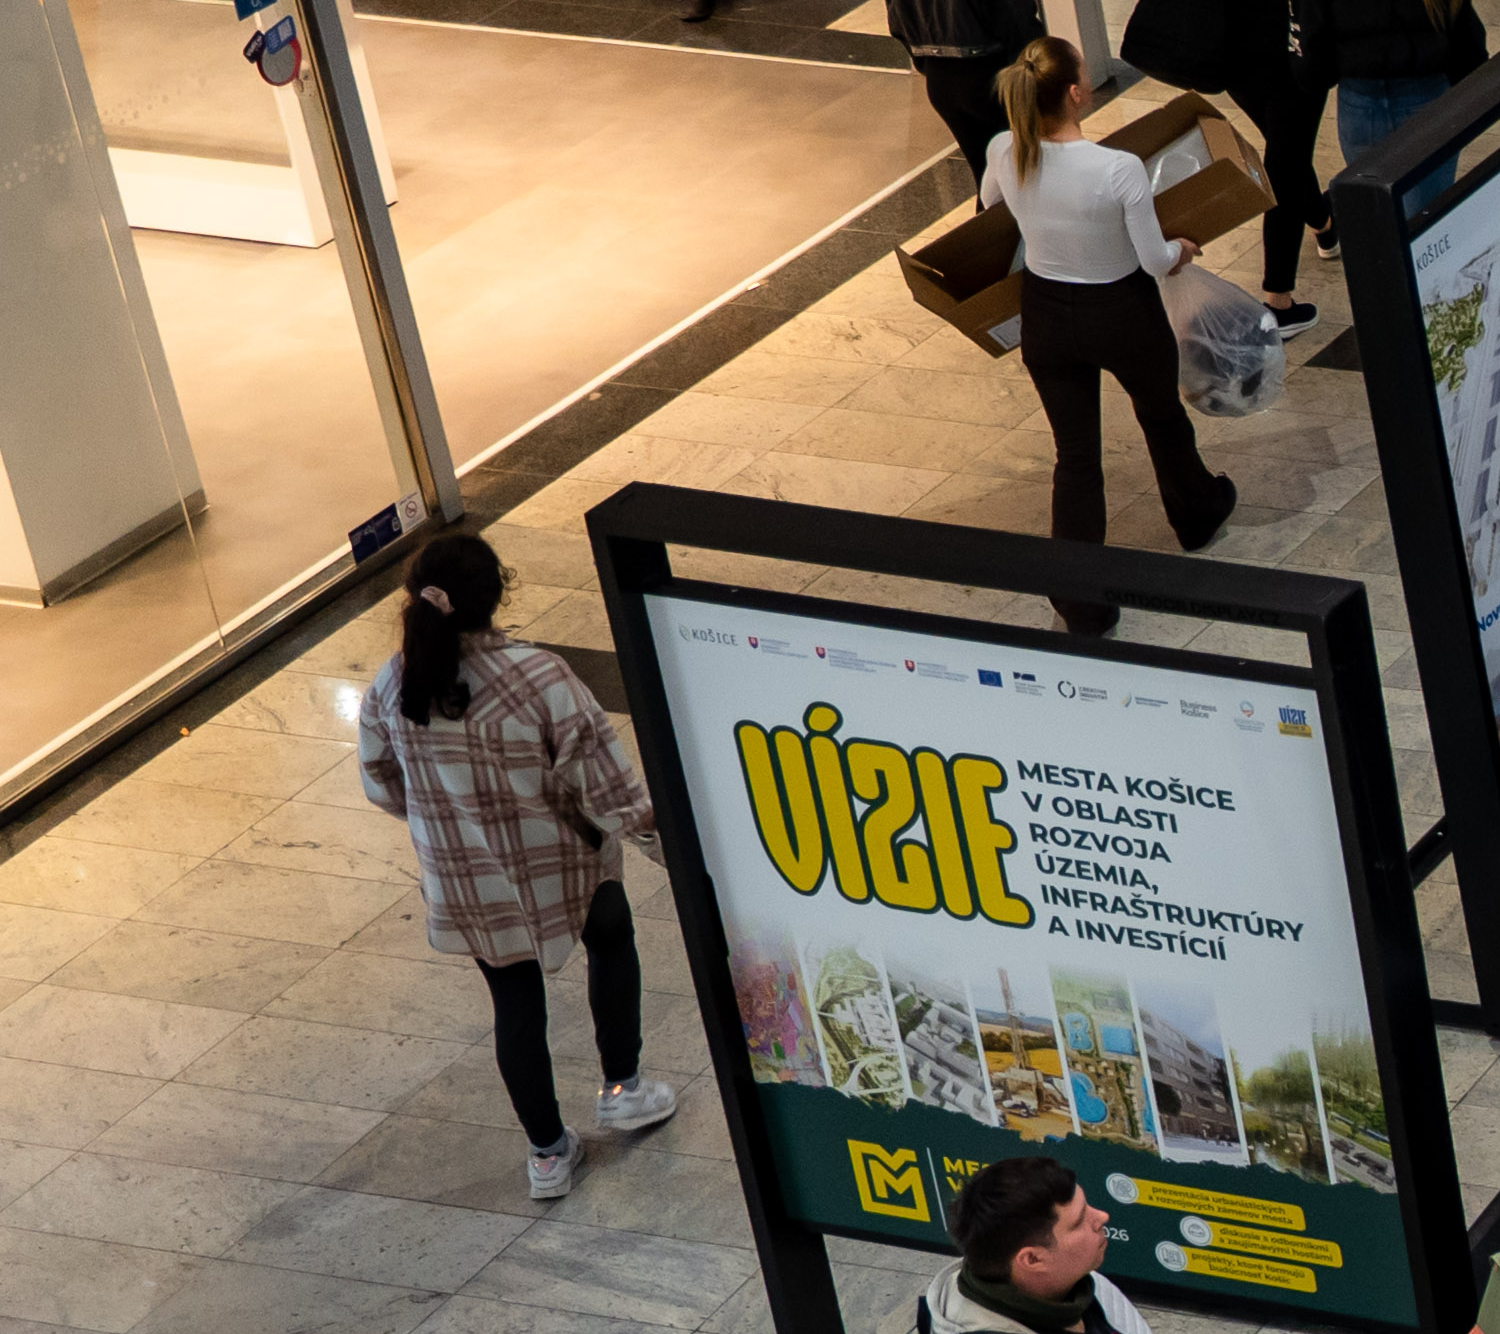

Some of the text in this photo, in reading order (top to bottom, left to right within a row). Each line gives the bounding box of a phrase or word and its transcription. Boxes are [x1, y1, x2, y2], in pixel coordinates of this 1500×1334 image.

[1415, 233, 1453, 273] KOŠICE
[692, 628, 738, 646] KOŠICE
[1017, 759, 1236, 812] MESTA KOŠICE
[734, 702, 1036, 928] VÍZIE
[1022, 792, 1178, 834] V OBLASTI
[1029, 822, 1172, 864] ROZVOJA
[1035, 850, 1159, 895] ÚZEMIA,
[1040, 883, 1305, 943] INFRAŠTRUKTÚRY
[1047, 915, 1228, 962] A INVESTÍCIÍ
[1152, 1185, 1210, 1203] prezentácia
[1262, 1211, 1293, 1225] mesta
